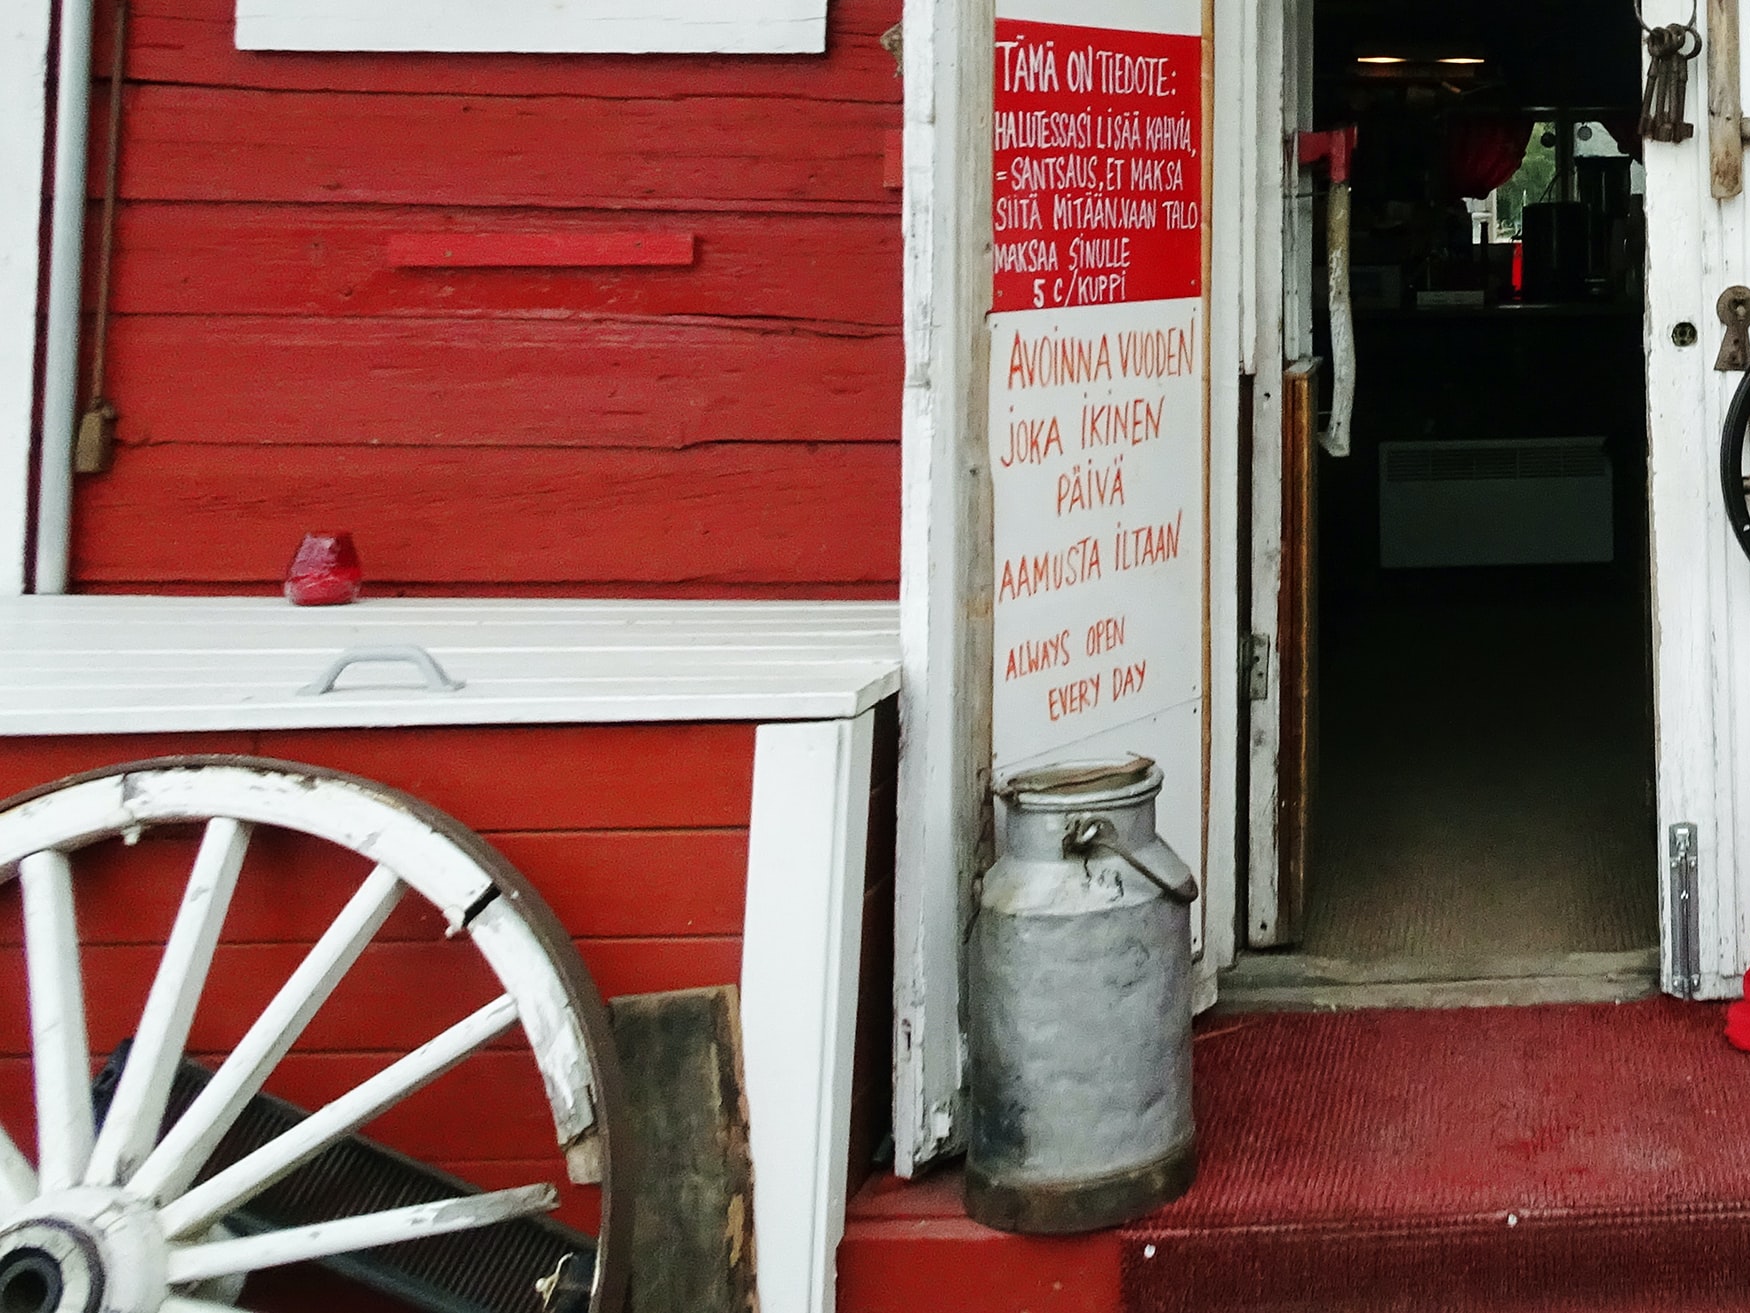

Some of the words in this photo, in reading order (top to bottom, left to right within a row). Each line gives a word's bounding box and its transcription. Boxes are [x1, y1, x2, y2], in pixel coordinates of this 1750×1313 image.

[995, 35, 1059, 93] TÄMÄ
[1067, 45, 1093, 93] ON
[1096, 51, 1177, 96] TIEDOTE:
[994, 106, 1092, 152] HALUTESSASI
[1097, 108, 1142, 150] LISÄÄ
[1146, 110, 1197, 158] KAHVIA,
[1106, 158, 1124, 191] ET
[1130, 158, 1183, 192] MAKSA
[995, 193, 1043, 231] SIITÄ
[1162, 200, 1198, 230] TALO
[994, 238, 1058, 274] MAKSAA
[1069, 233, 1130, 271] SINULLE
[1033, 278, 1045, 308] 5
[1008, 325, 1112, 391] AVOINNA
[1118, 317, 1195, 380] VUODEN
[1000, 406, 1063, 467] JOKA
[1080, 389, 1166, 450] IKINEN
[1057, 454, 1125, 517] PÄIVÄ
[998, 536, 1101, 604] AAMUSTA
[1114, 509, 1183, 571] ILTAAN
[1005, 629, 1070, 682] ALWAYS
[1085, 615, 1125, 657] OPEN
[1048, 673, 1101, 722] EVERY
[1111, 660, 1147, 701] DAY
